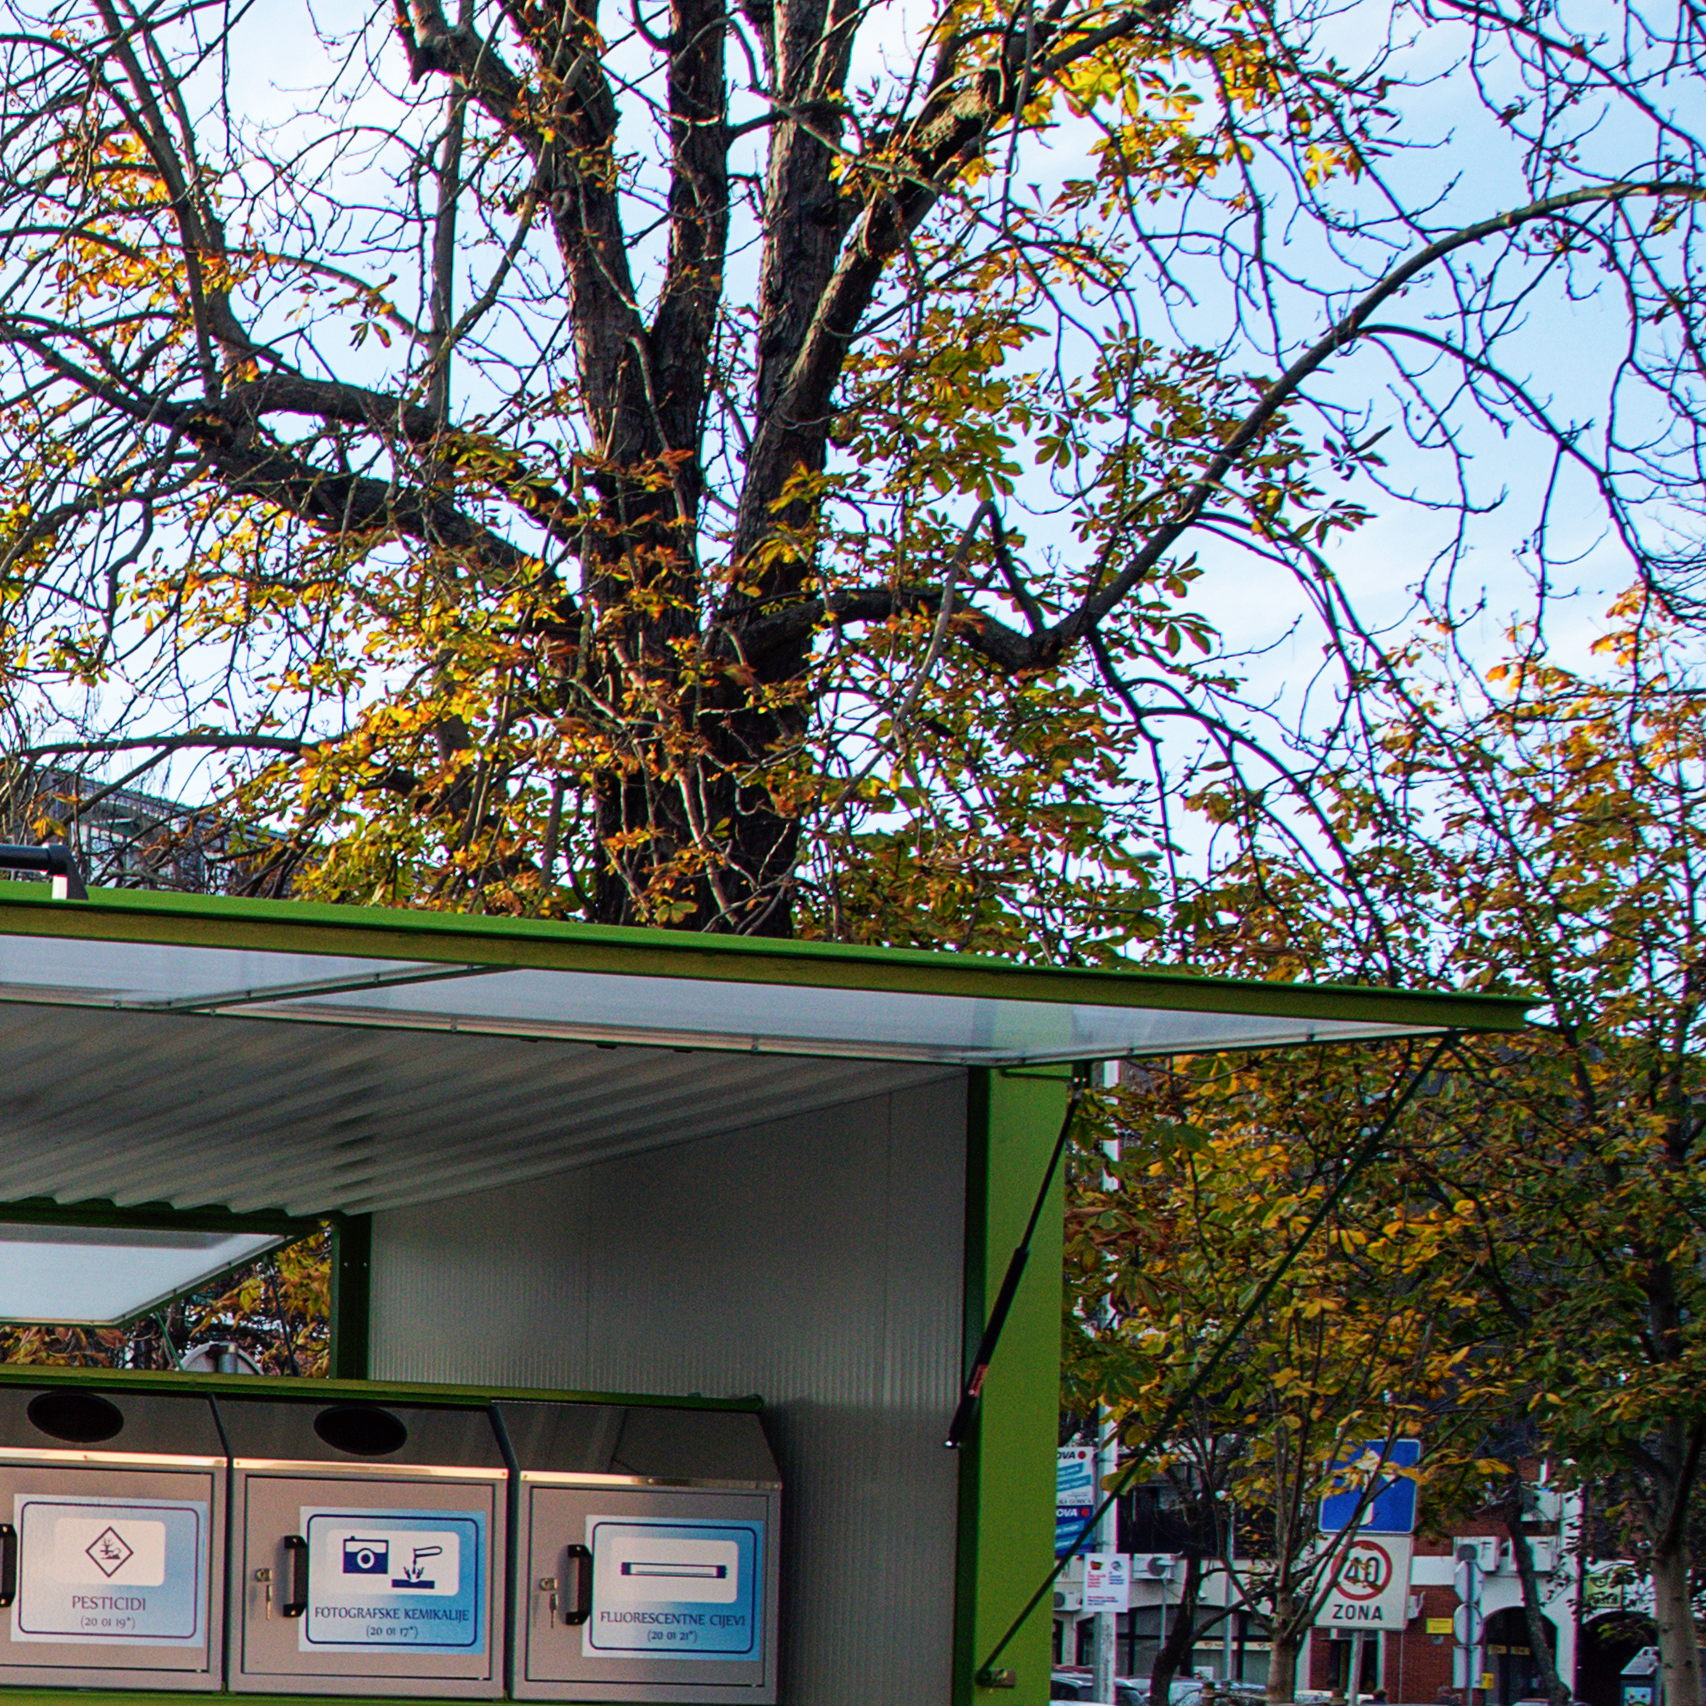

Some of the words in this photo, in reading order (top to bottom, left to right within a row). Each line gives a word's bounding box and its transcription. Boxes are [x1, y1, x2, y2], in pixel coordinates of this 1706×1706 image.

[1343, 1557, 1380, 1584] 40
[72, 1595, 146, 1612] PESTICIDI
[315, 1606, 400, 1621] FOTOGRAFSKE
[404, 1608, 469, 1623] KEMIKALIJE
[600, 1611, 705, 1626] FLUORESCENTNE
[709, 1613, 746, 1629] CIJEVI
[1332, 1604, 1383, 1621] ZONA
[80, 1614, 98, 1630] (20
[102, 1617, 112, 1627] 01
[366, 1625, 383, 1639] (20
[386, 1627, 396, 1636] 01
[647, 1629, 663, 1643] (20
